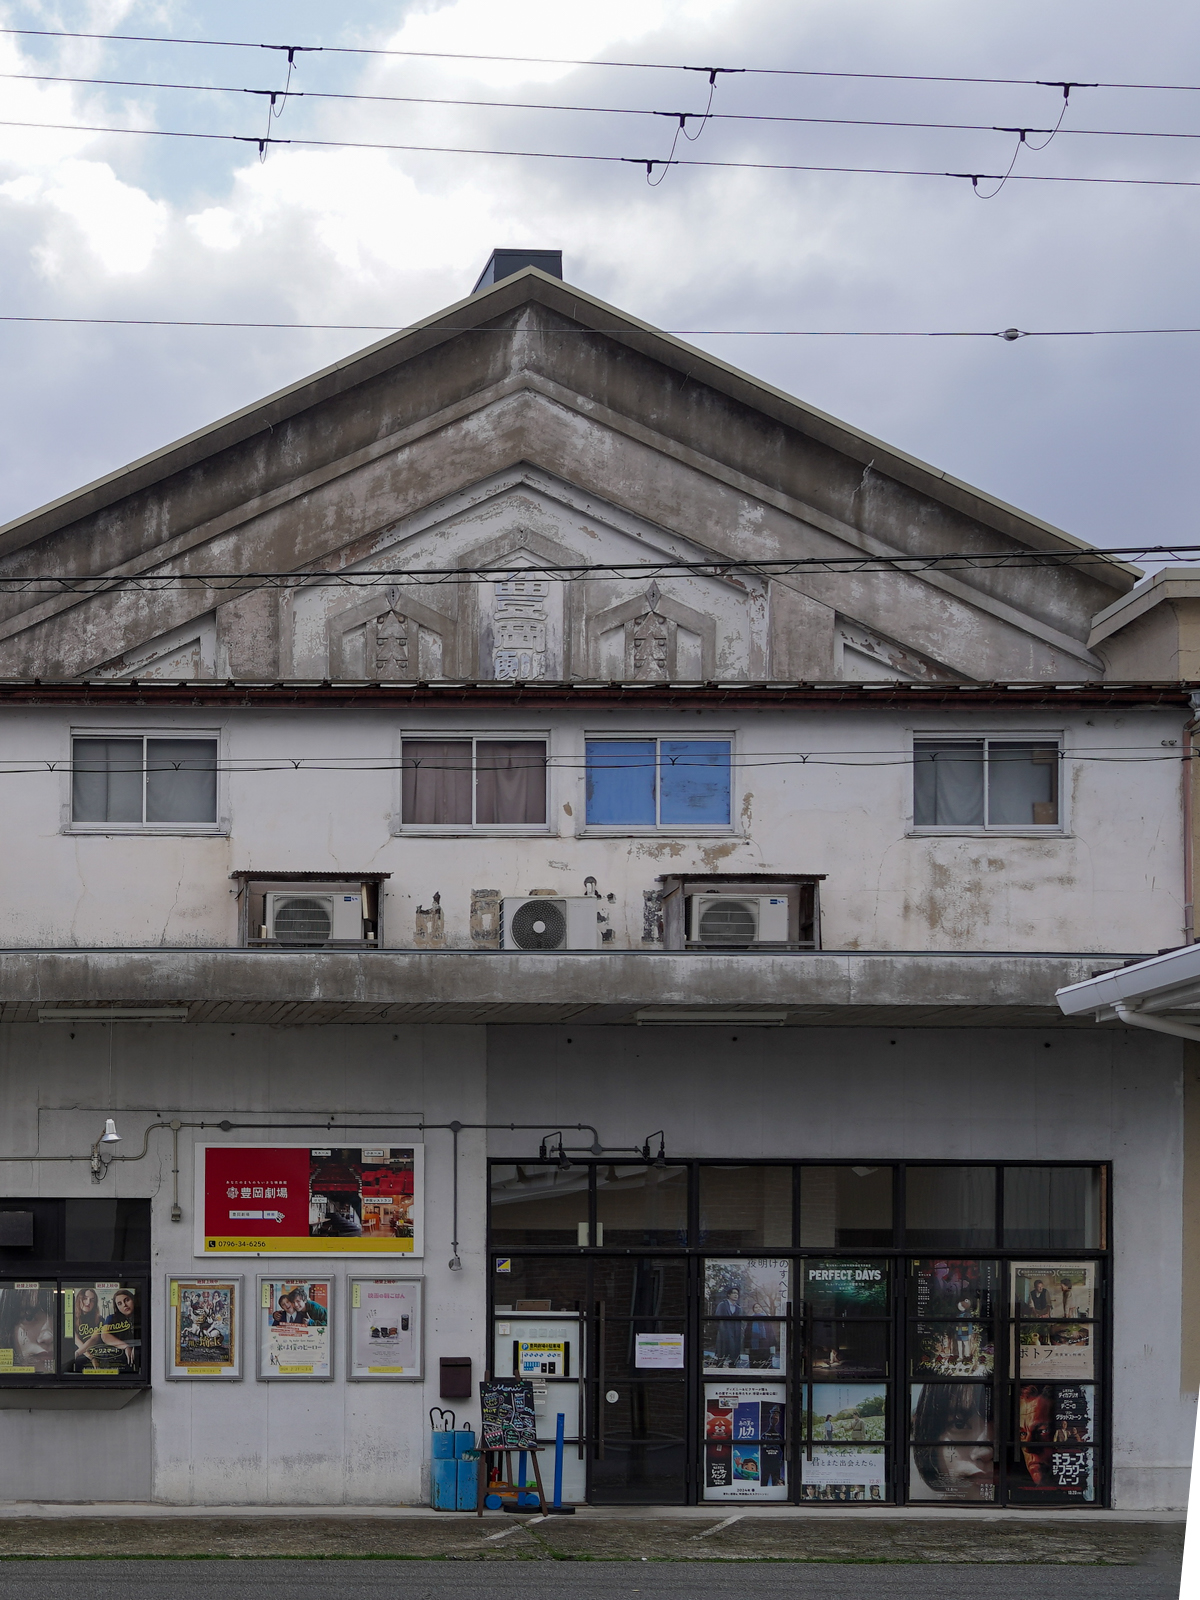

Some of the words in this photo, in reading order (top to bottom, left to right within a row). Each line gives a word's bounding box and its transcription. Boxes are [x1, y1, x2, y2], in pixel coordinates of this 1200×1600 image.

[240, 1187, 288, 1199] 豊岡劇場
[809, 1270, 853, 1281] PERFECT
[855, 1270, 881, 1281] DAYS
[1052, 1453, 1085, 1465] キラーズ
[1058, 1475, 1079, 1485] ムーン
